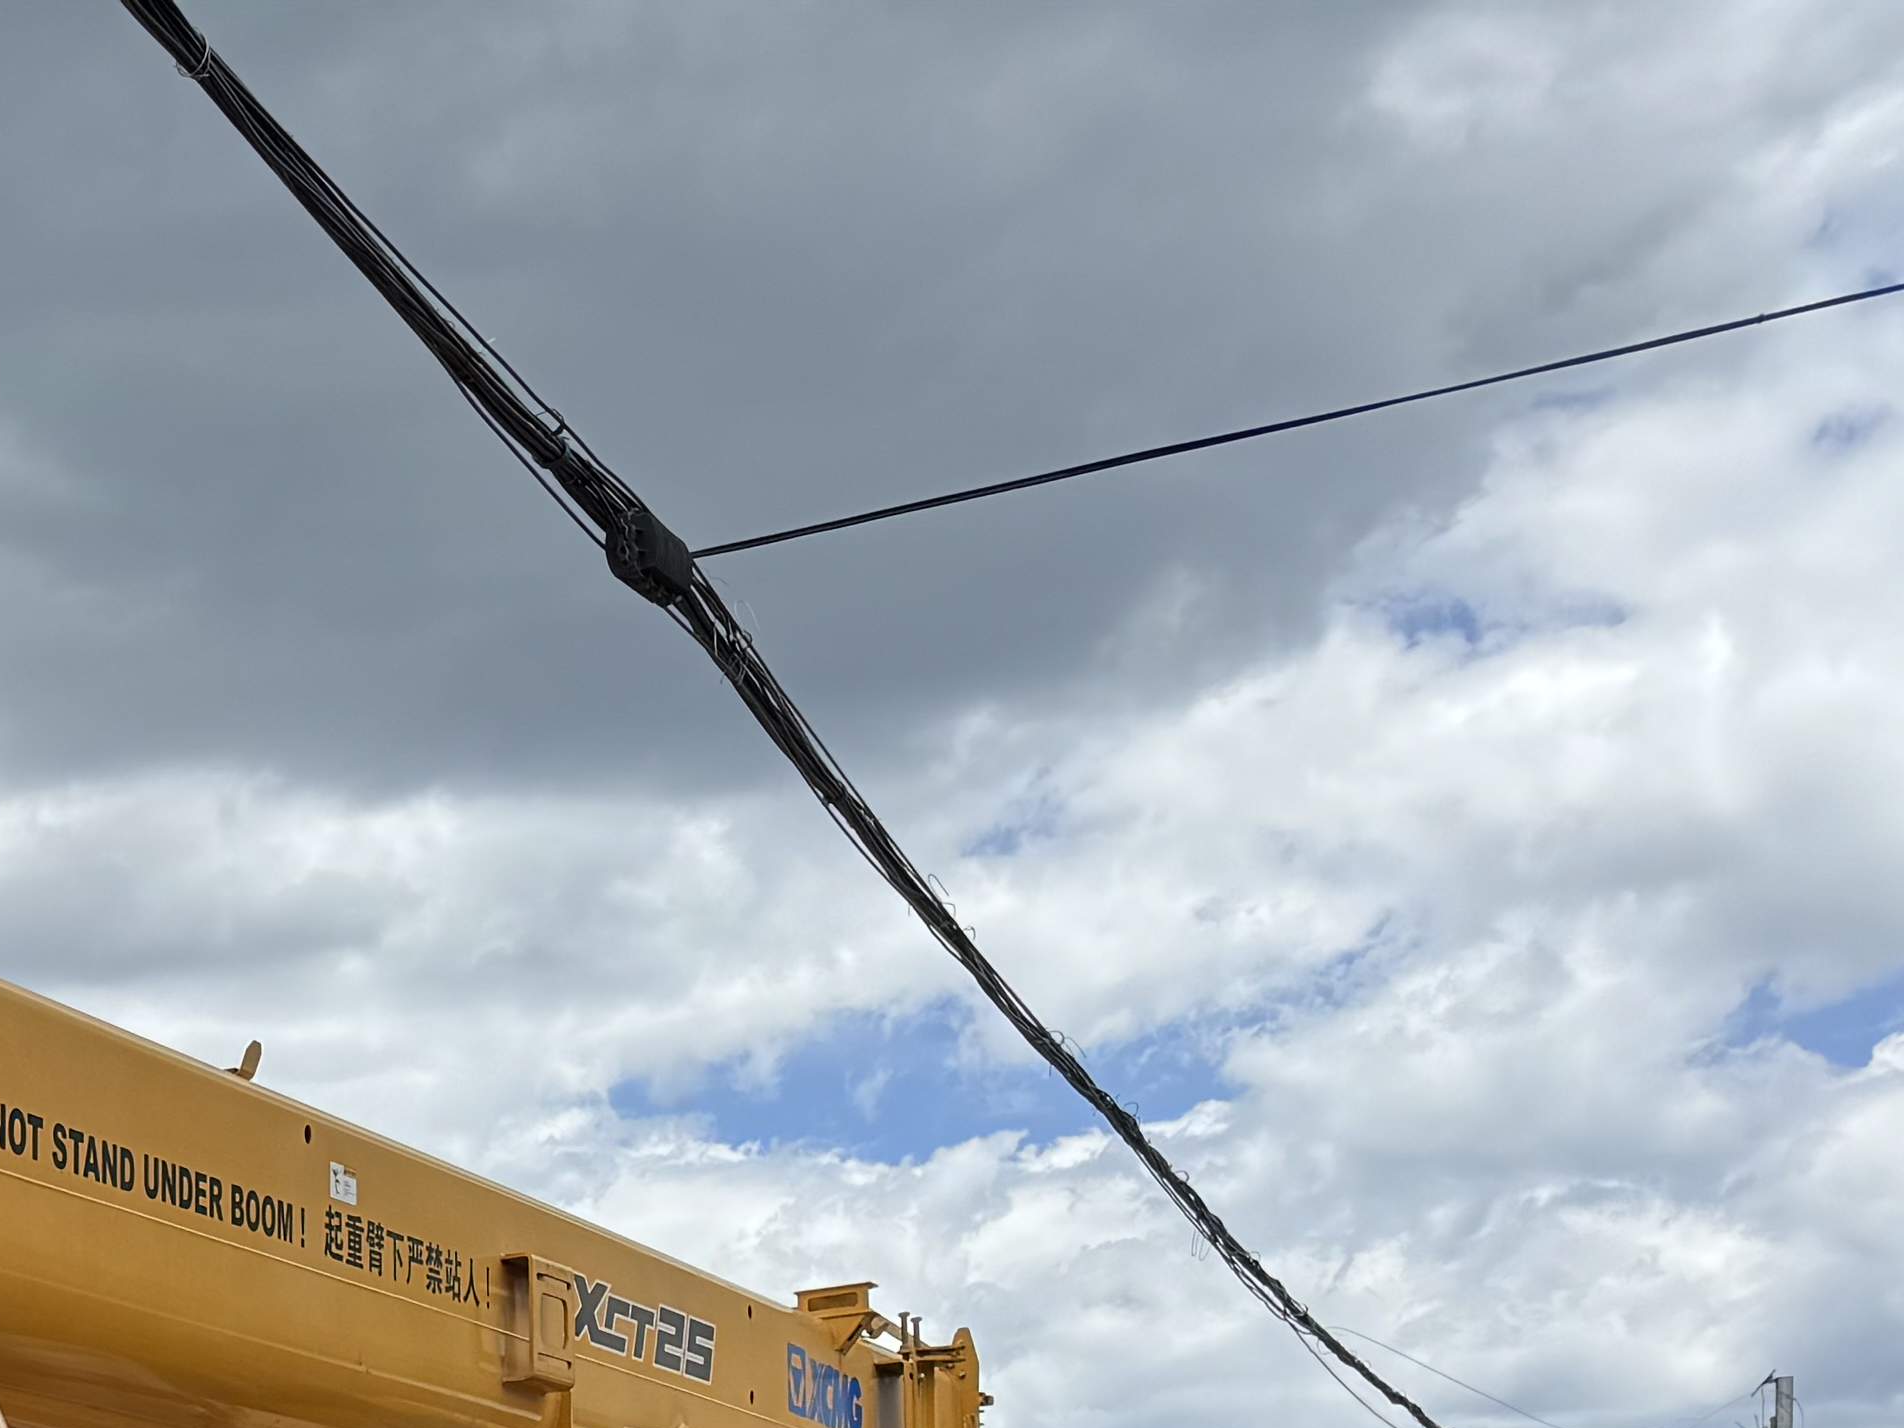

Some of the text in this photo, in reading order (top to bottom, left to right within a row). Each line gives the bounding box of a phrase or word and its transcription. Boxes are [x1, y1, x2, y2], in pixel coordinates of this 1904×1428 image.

[52, 1122, 135, 1192] STAND
[143, 1153, 224, 1222] UNDER
[573, 1272, 716, 1386] XCT25
